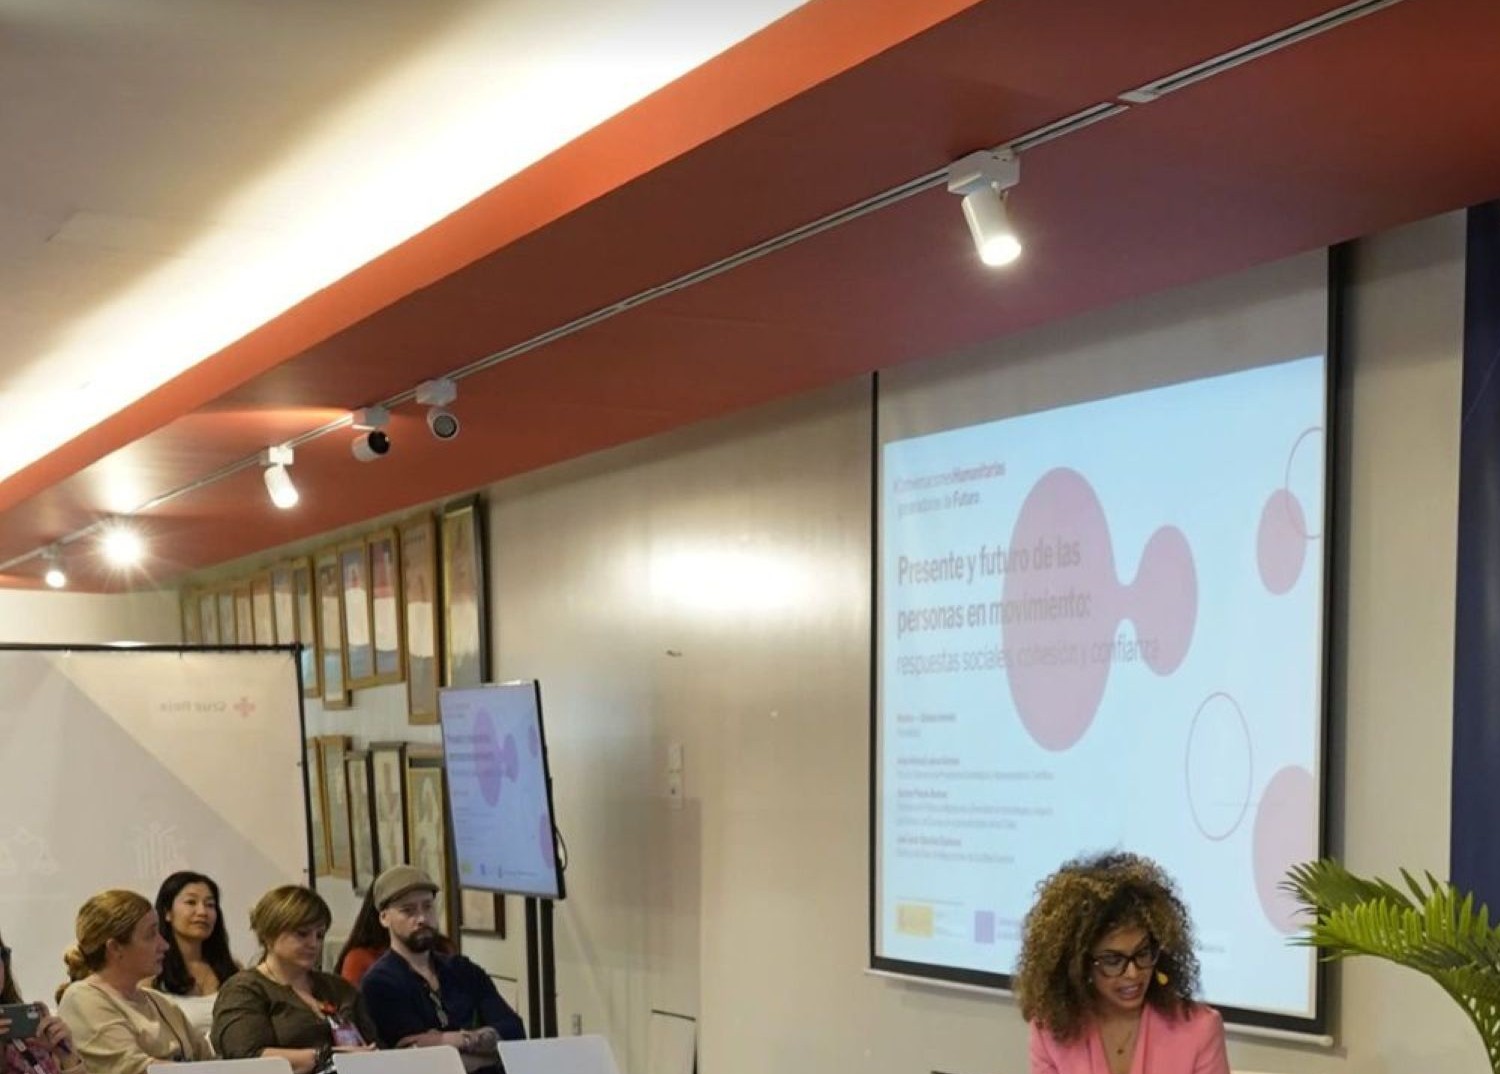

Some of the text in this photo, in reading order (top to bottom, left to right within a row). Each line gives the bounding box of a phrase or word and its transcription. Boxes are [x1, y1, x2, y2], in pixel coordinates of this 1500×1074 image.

[897, 535, 1082, 586] Presente y futuro de las
[897, 586, 1092, 640] personas en movimiento:
